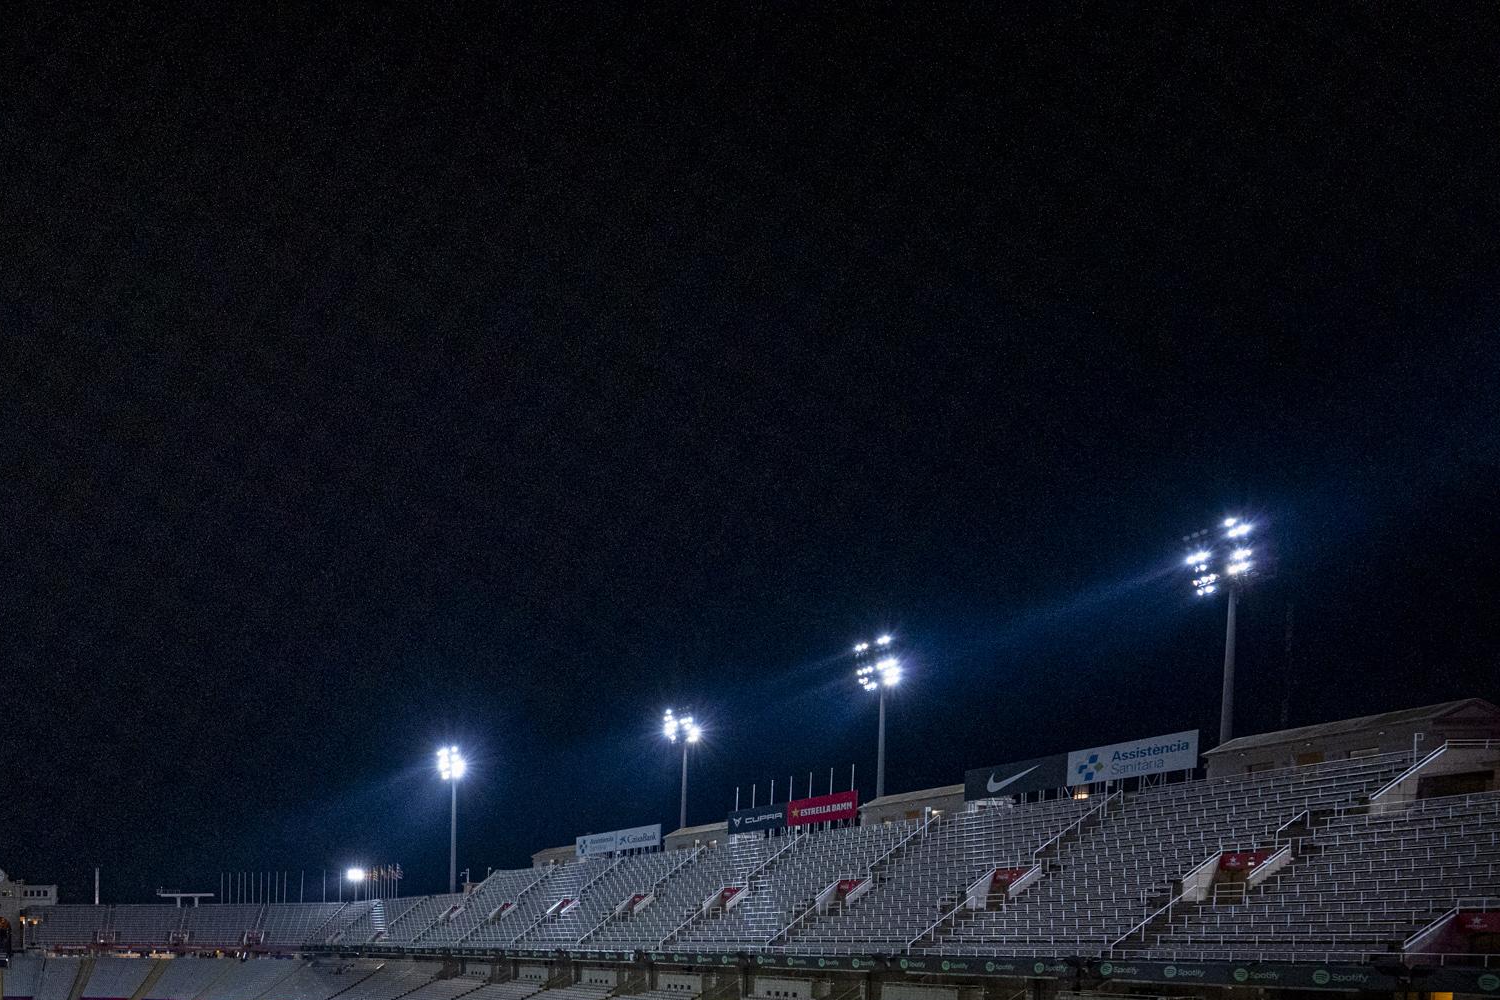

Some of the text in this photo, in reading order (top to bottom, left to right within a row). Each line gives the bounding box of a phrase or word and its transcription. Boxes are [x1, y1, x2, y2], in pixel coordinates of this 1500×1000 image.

[1112, 740, 1189, 762] Assistència
[800, 801, 853, 817] ESTRELLA DAMM
[745, 812, 783, 824] CUPRA
[950, 961, 968, 970] Spotify
[995, 963, 1015, 972] Spotify
[1044, 963, 1068, 973] Spotify
[1113, 965, 1140, 975] Spotify
[1177, 967, 1205, 978] Spotify
[1250, 970, 1280, 980] Spotify
[1331, 973, 1370, 985] Spotify
